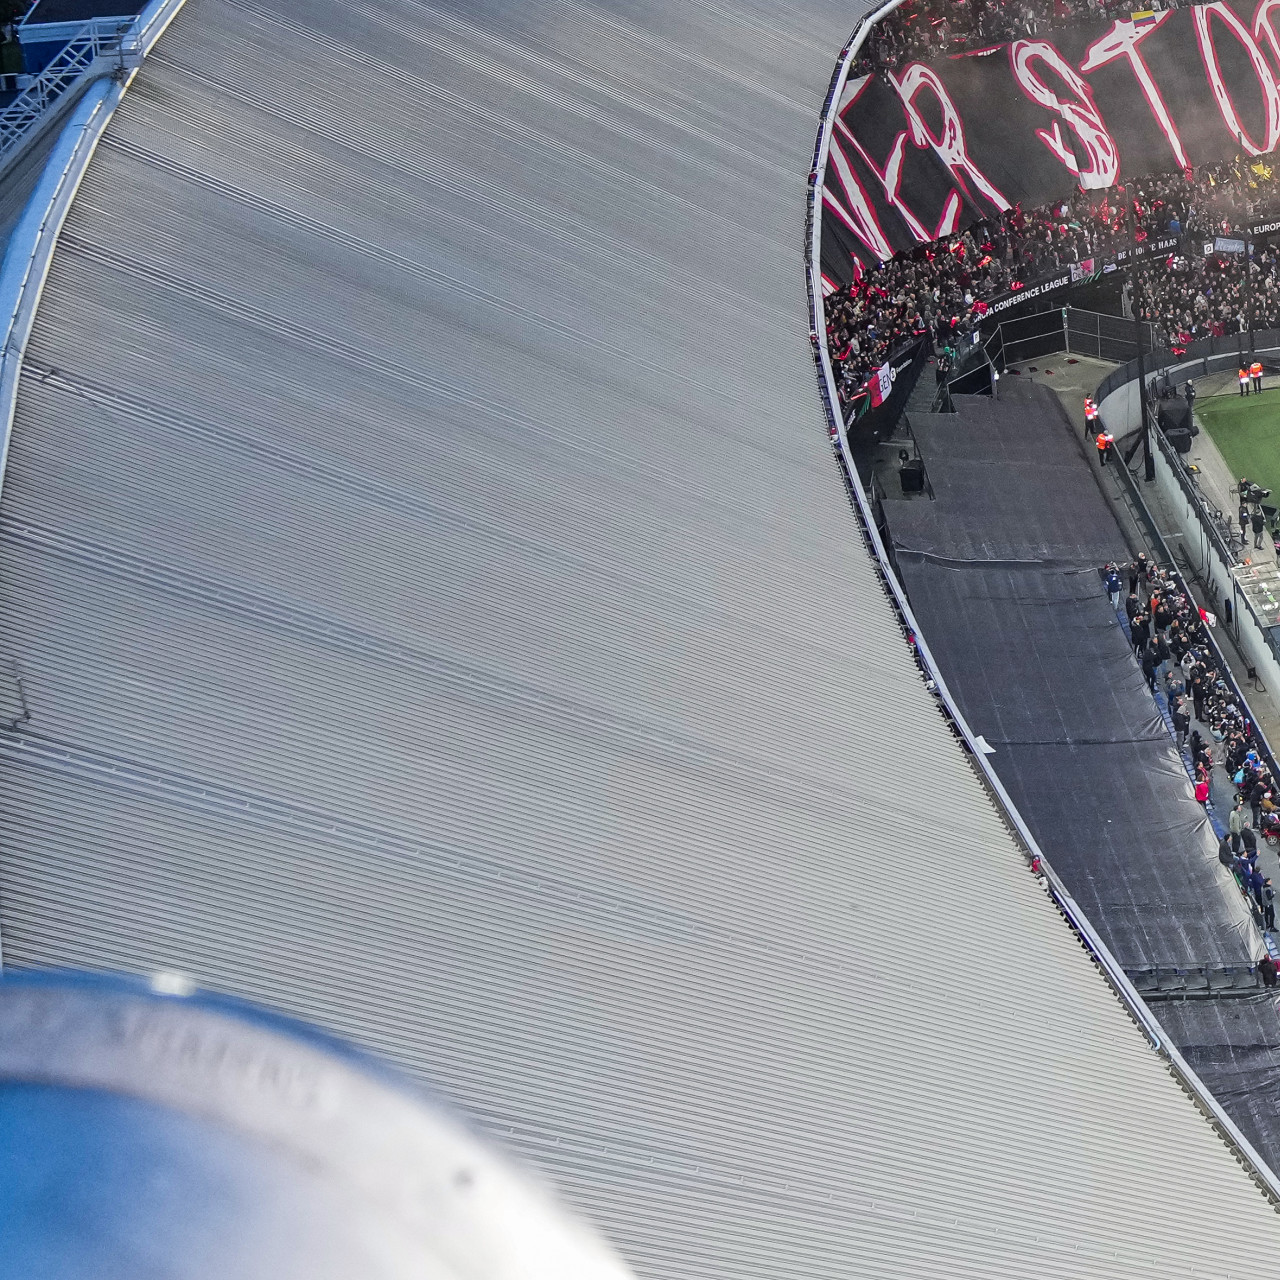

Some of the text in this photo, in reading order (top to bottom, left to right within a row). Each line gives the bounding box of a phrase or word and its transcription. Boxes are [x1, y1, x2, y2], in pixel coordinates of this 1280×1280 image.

[1158, 238, 1178, 250] HAAS
[994, 287, 1040, 313] CONFERENCE
[1040, 276, 1069, 293] LEAGUE
